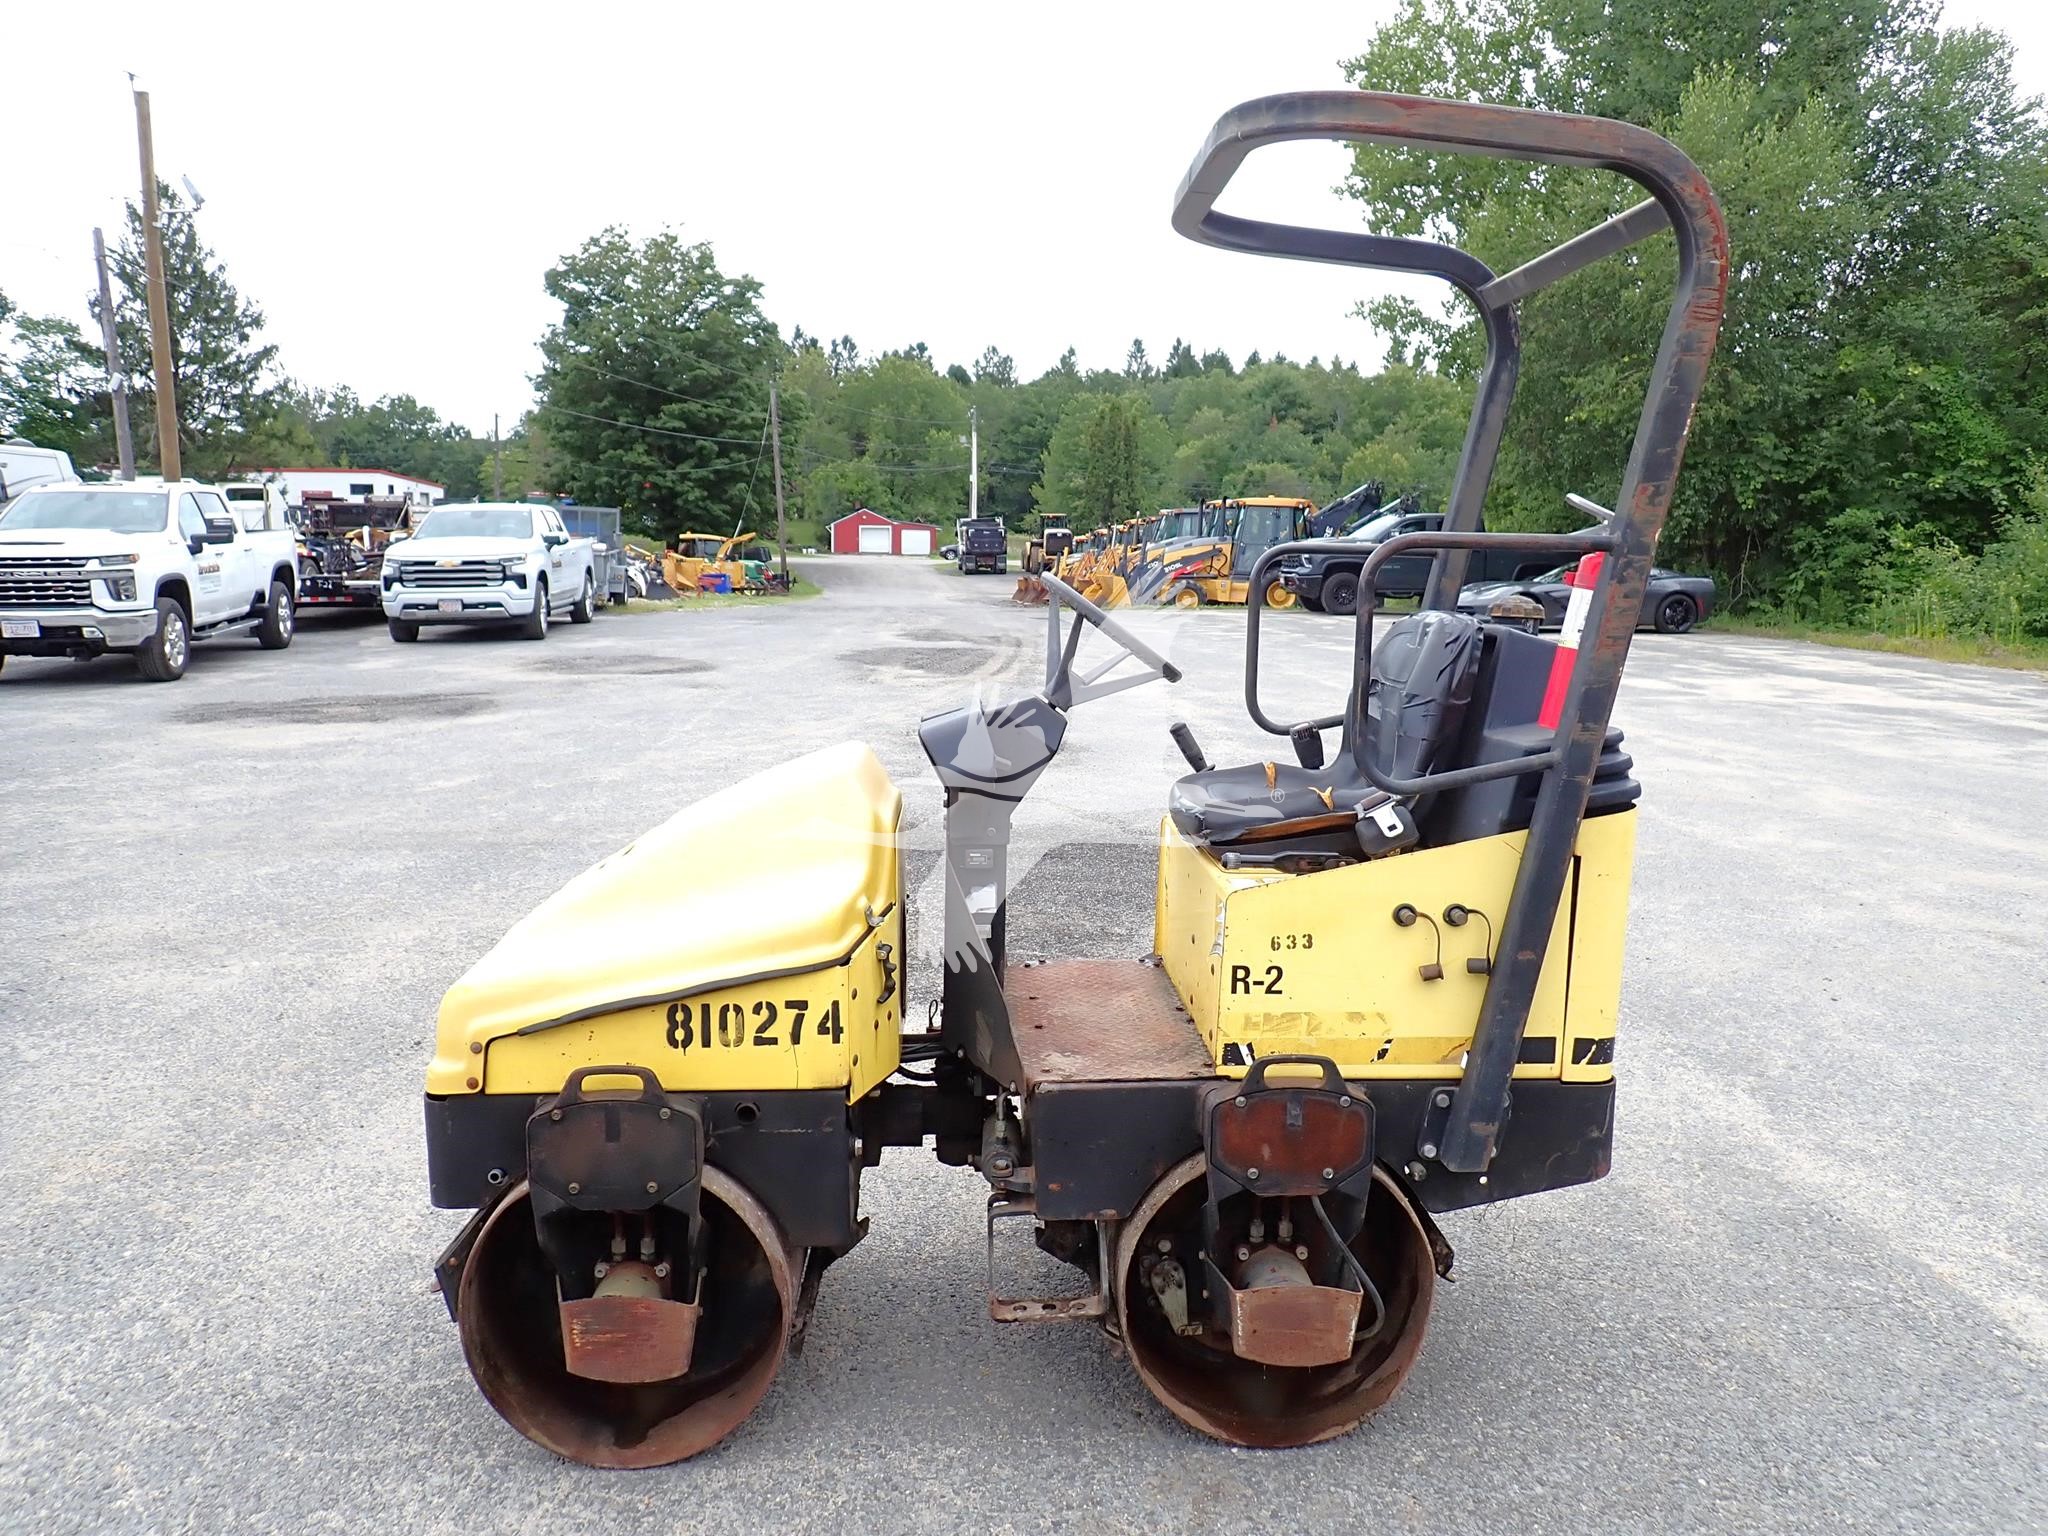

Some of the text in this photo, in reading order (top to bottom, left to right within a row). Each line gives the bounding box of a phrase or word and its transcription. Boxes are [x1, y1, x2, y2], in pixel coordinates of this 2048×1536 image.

[1270, 933, 1314, 951] 633
[1230, 965, 1284, 995] R-2
[666, 999, 844, 1051] 810274
